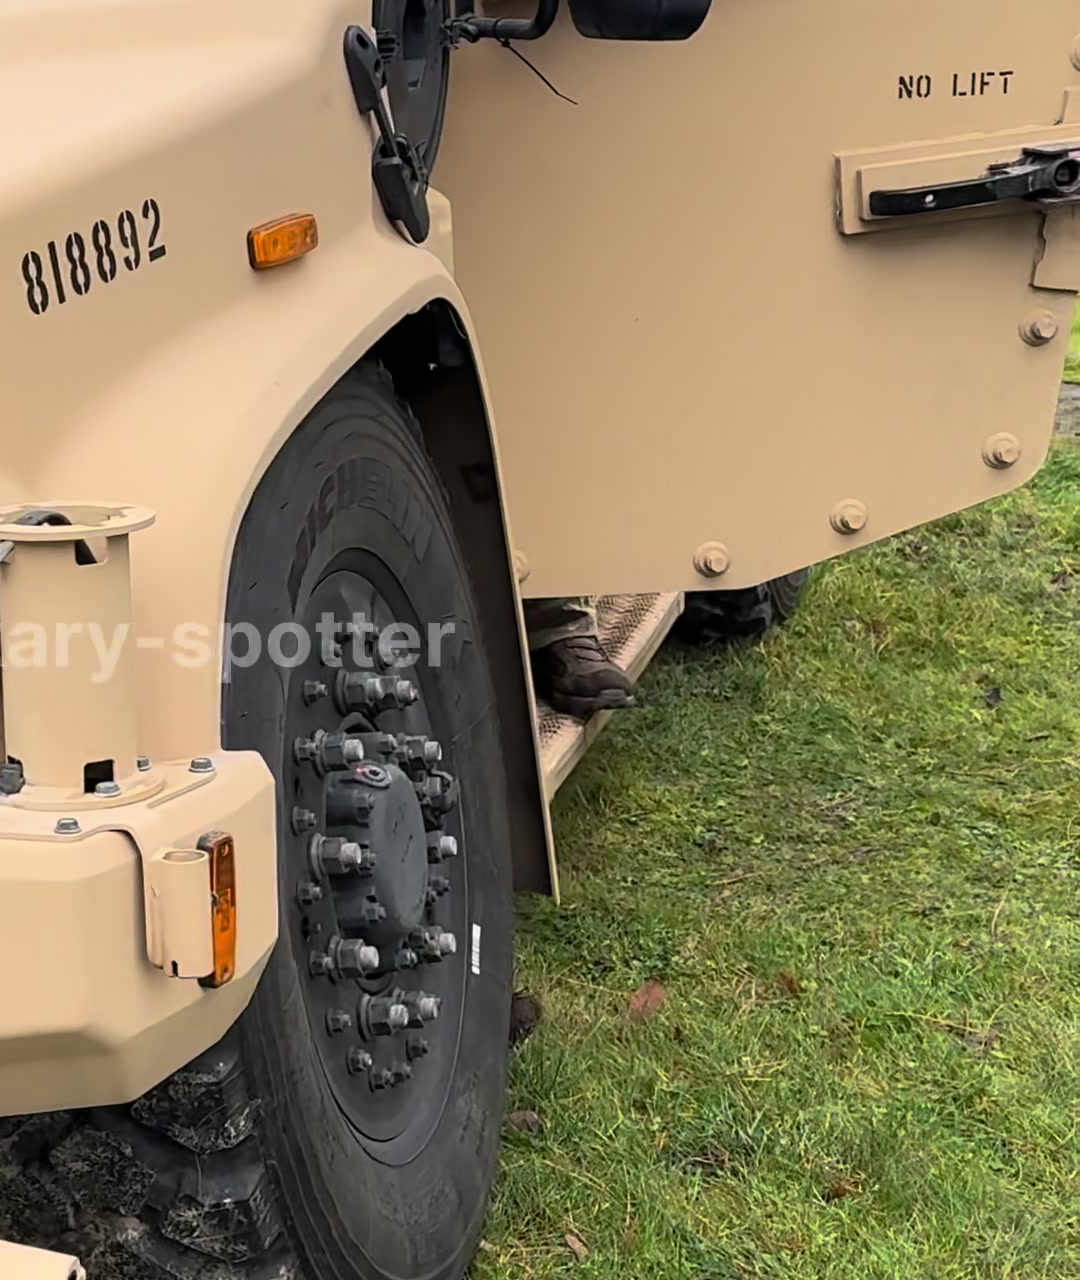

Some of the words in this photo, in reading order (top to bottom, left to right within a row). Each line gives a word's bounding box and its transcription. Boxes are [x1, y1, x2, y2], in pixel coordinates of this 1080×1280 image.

[898, 75, 931, 99] NO
[953, 70, 1014, 96] LIFT
[21, 198, 166, 315] 818892
